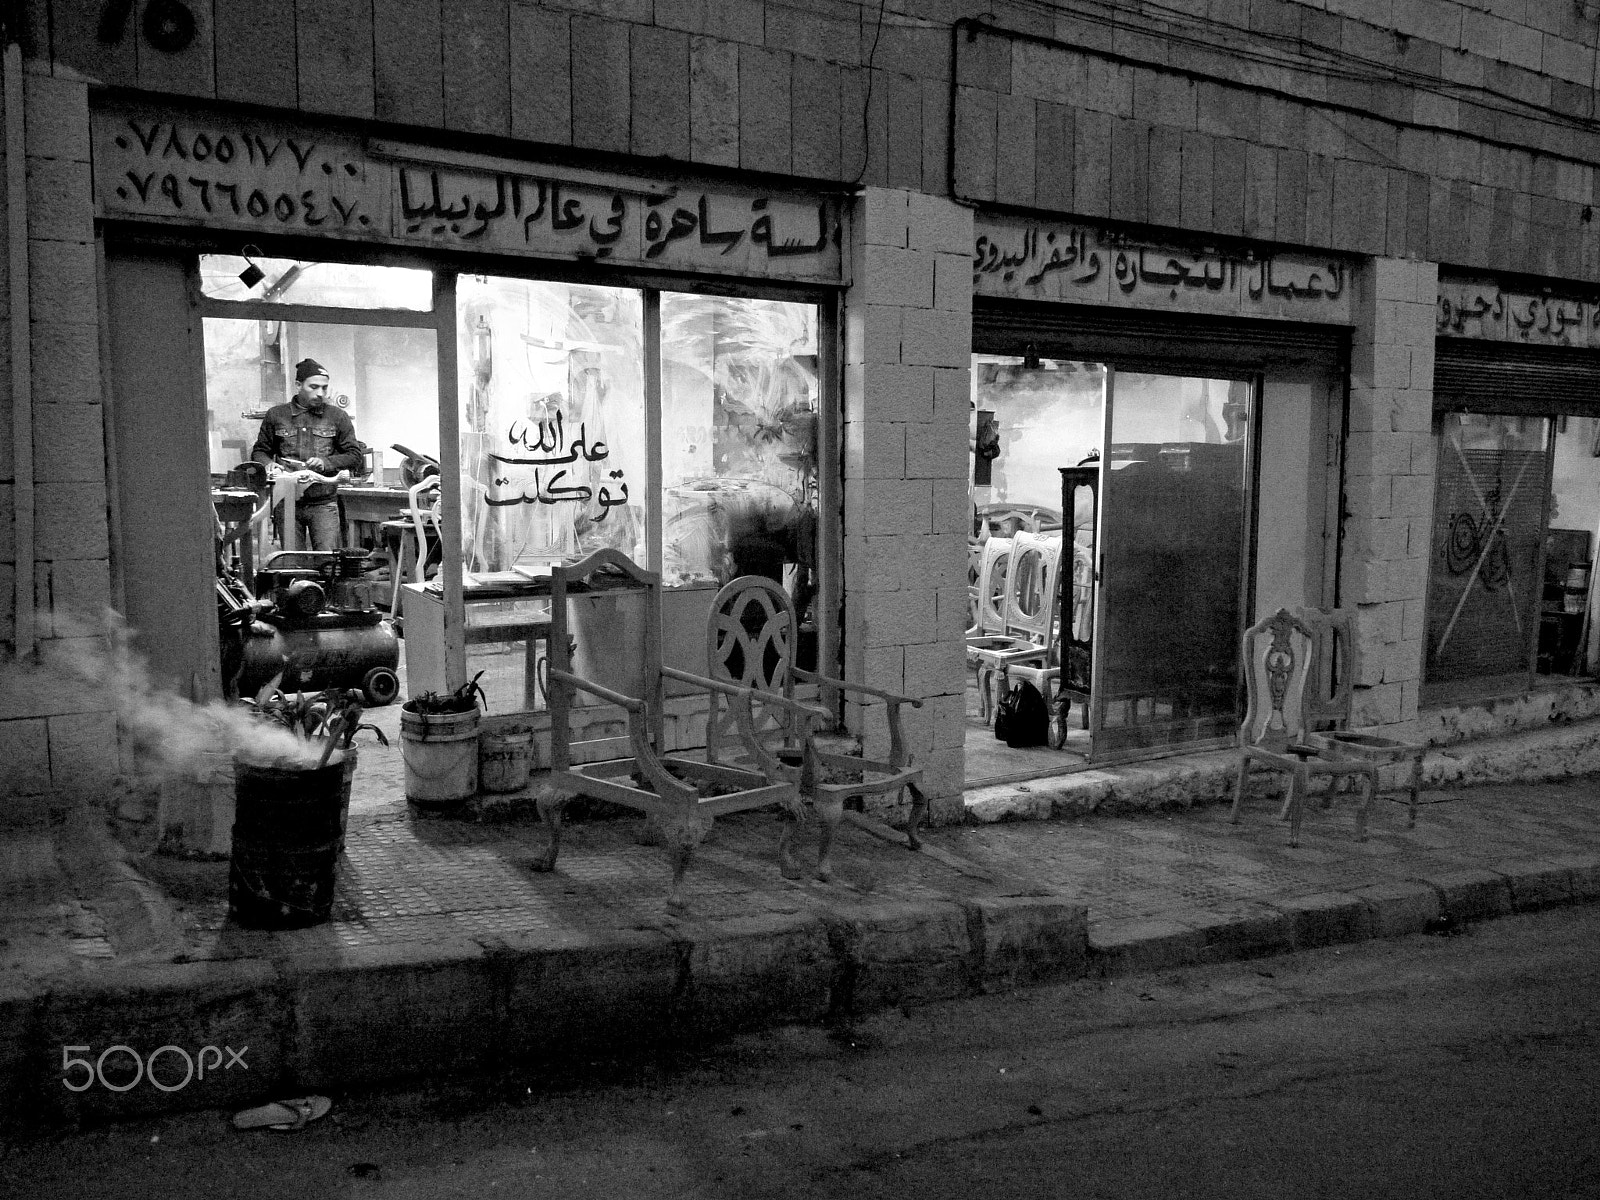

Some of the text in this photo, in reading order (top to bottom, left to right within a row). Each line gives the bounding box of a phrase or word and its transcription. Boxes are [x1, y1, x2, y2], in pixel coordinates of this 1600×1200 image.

[116, 169, 371, 226] ٠٧٩٦٦٥٥٤٧٠
[589, 193, 626, 259] في
[645, 194, 746, 259] ساحرة
[488, 409, 609, 465] على الله
[484, 467, 629, 522] توكلت
